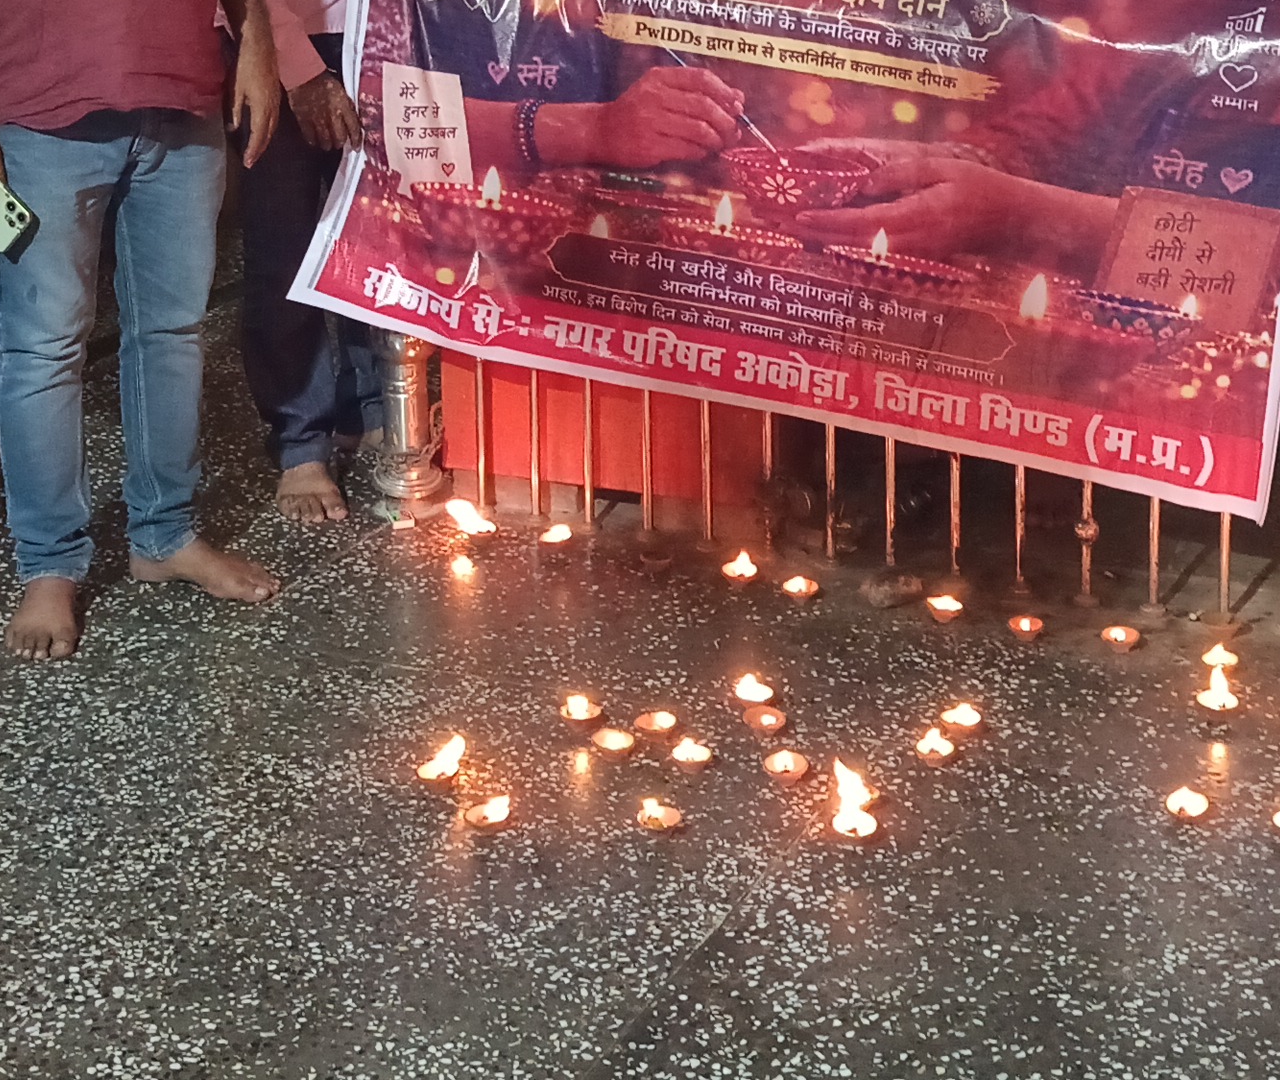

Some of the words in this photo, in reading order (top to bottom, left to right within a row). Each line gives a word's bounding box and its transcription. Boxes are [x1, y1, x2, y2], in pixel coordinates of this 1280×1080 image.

[751, 7, 776, 29] जी
[778, 10, 798, 31] के
[801, 16, 882, 45] जन्मदिवस
[885, 26, 903, 50] के
[967, 45, 989, 65] पर
[635, 21, 703, 48] PwIDDs
[705, 32, 735, 56] द्वारा
[737, 36, 759, 58] प्रेम
[761, 39, 776, 60] से
[778, 44, 847, 72] हस्तनिर्मित
[850, 57, 914, 83] कलात्मक
[916, 67, 958, 92] दीपक
[517, 56, 560, 90] स्नेह
[399, 81, 420, 100] मेरे
[1211, 94, 1259, 112] सम्मान
[402, 105, 429, 123] हुनर
[396, 126, 416, 140] एक
[404, 146, 439, 160] समाज
[1152, 148, 1209, 189] स्नेह
[1154, 211, 1201, 234] छोटी
[1195, 241, 1217, 265] से
[609, 246, 640, 267] स्नेह
[646, 250, 675, 273] दीप
[681, 257, 729, 283] खरीदें
[733, 267, 763, 290] और
[770, 273, 853, 309] दिव्यांगजनों
[858, 292, 874, 312] के
[879, 298, 928, 324] कौशल
[1136, 267, 1172, 291] बड़ी
[1179, 268, 1237, 295] रोशनी
[659, 278, 757, 308] आत्मनिर्भरता
[760, 294, 781, 314] को
[786, 299, 857, 330] प्रोत्साहित
[541, 283, 582, 306] आइए,
[586, 293, 606, 309] इस
[610, 294, 648, 316] विशेष
[652, 302, 677, 322] दिन
[680, 307, 700, 325] को
[703, 310, 735, 333] सेवा,
[739, 320, 784, 341] सम्मान
[788, 327, 814, 346] और
[818, 335, 844, 356] स्नेह
[848, 342, 867, 360] की
[871, 344, 910, 368] रोशनी
[915, 354, 928, 372] से
[544, 315, 617, 358] नगर
[623, 326, 727, 379] परिषद
[873, 372, 970, 426] जिला
[979, 395, 1074, 448] भिण्ड
[1084, 413, 1216, 488] (म.प्र.)
